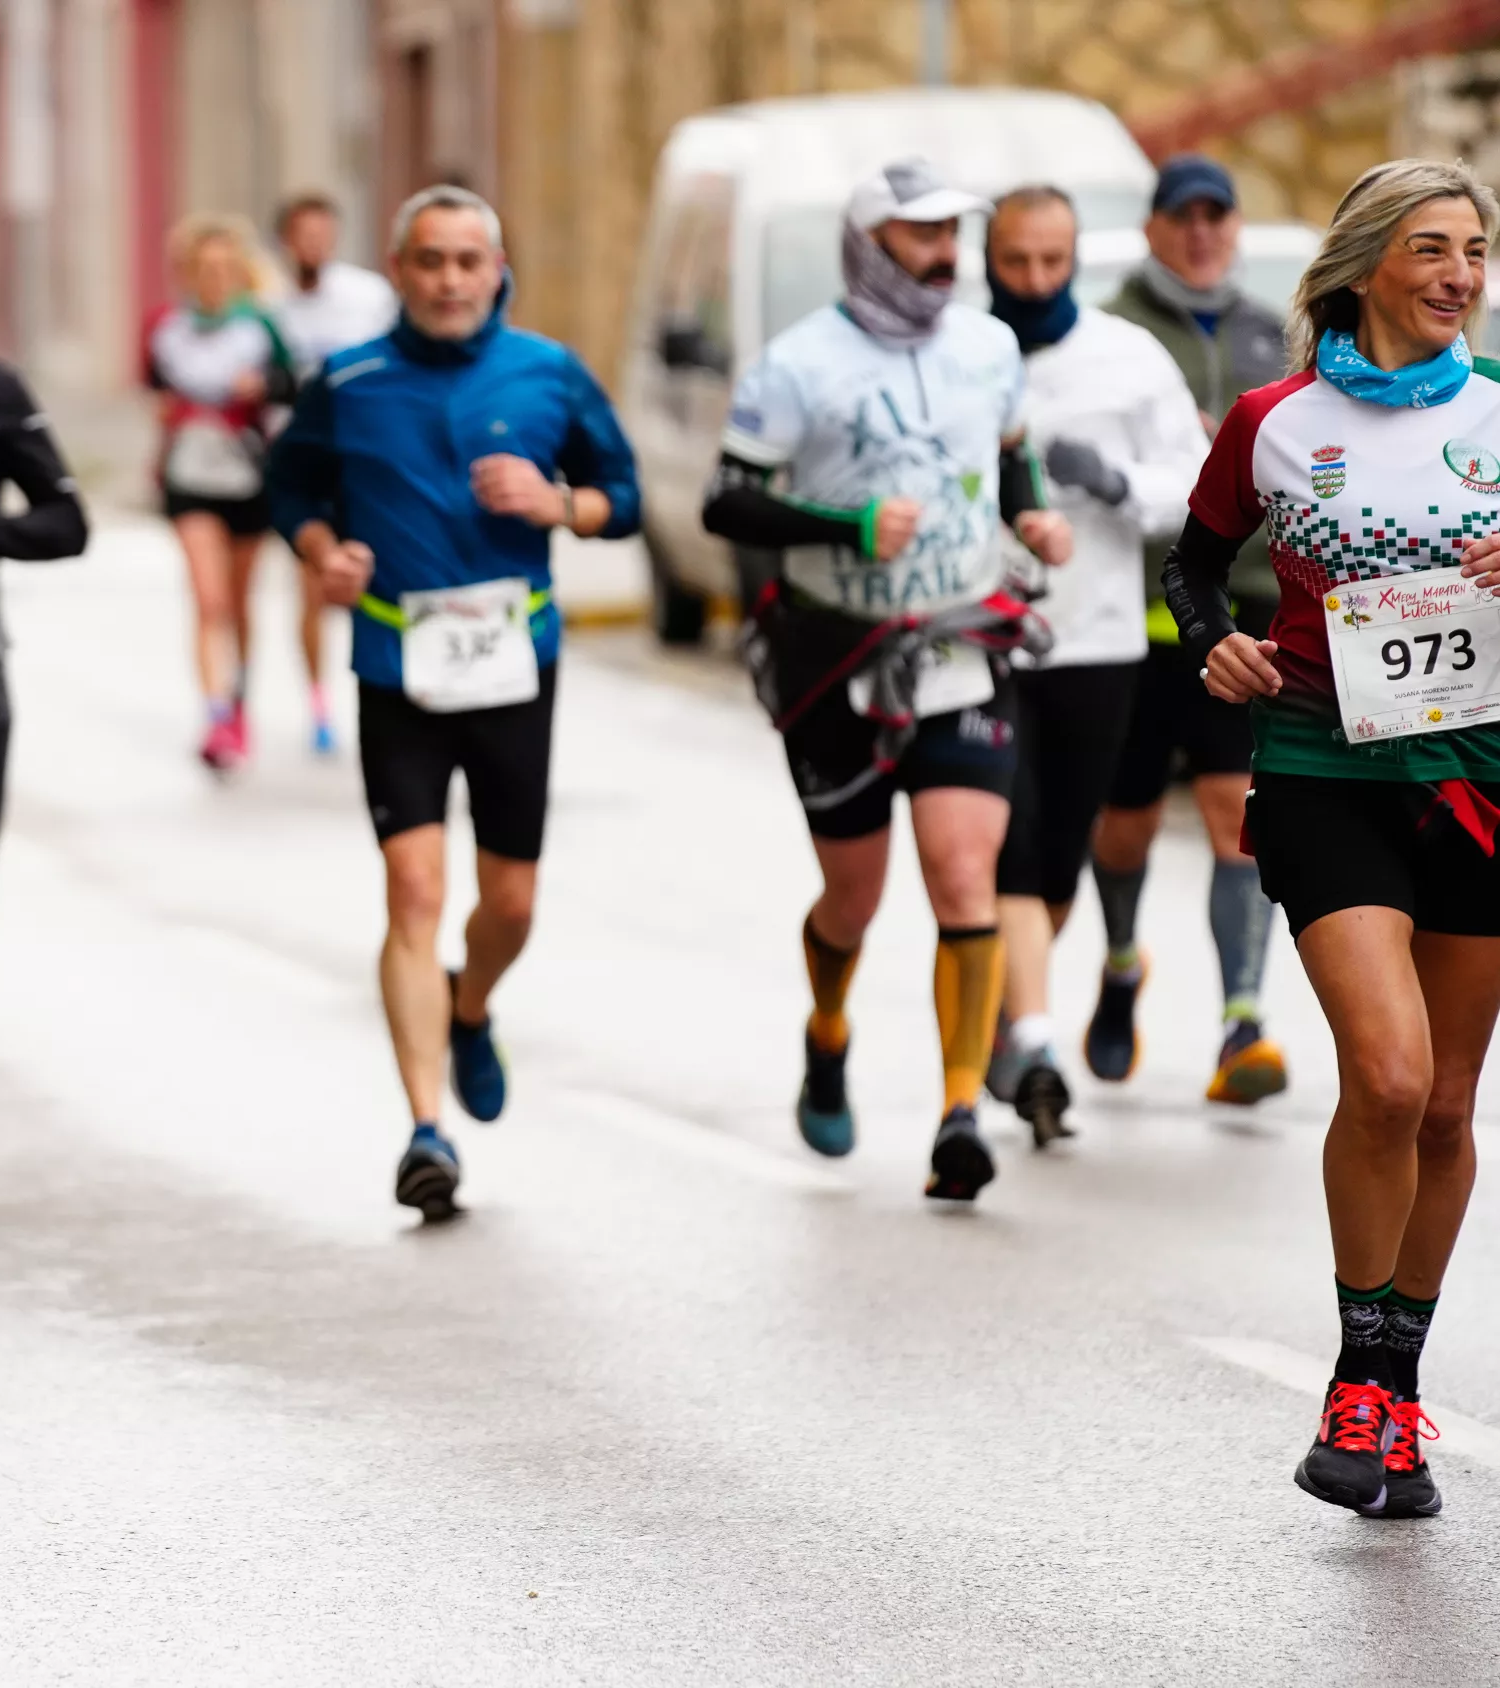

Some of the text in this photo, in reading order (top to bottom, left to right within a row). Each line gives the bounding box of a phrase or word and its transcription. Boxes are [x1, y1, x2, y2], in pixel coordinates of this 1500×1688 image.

[1401, 600, 1460, 620] LUCENA
[1381, 628, 1476, 681] 973
[1394, 690, 1420, 699] SUSANA
[1421, 686, 1450, 695] MORENO
